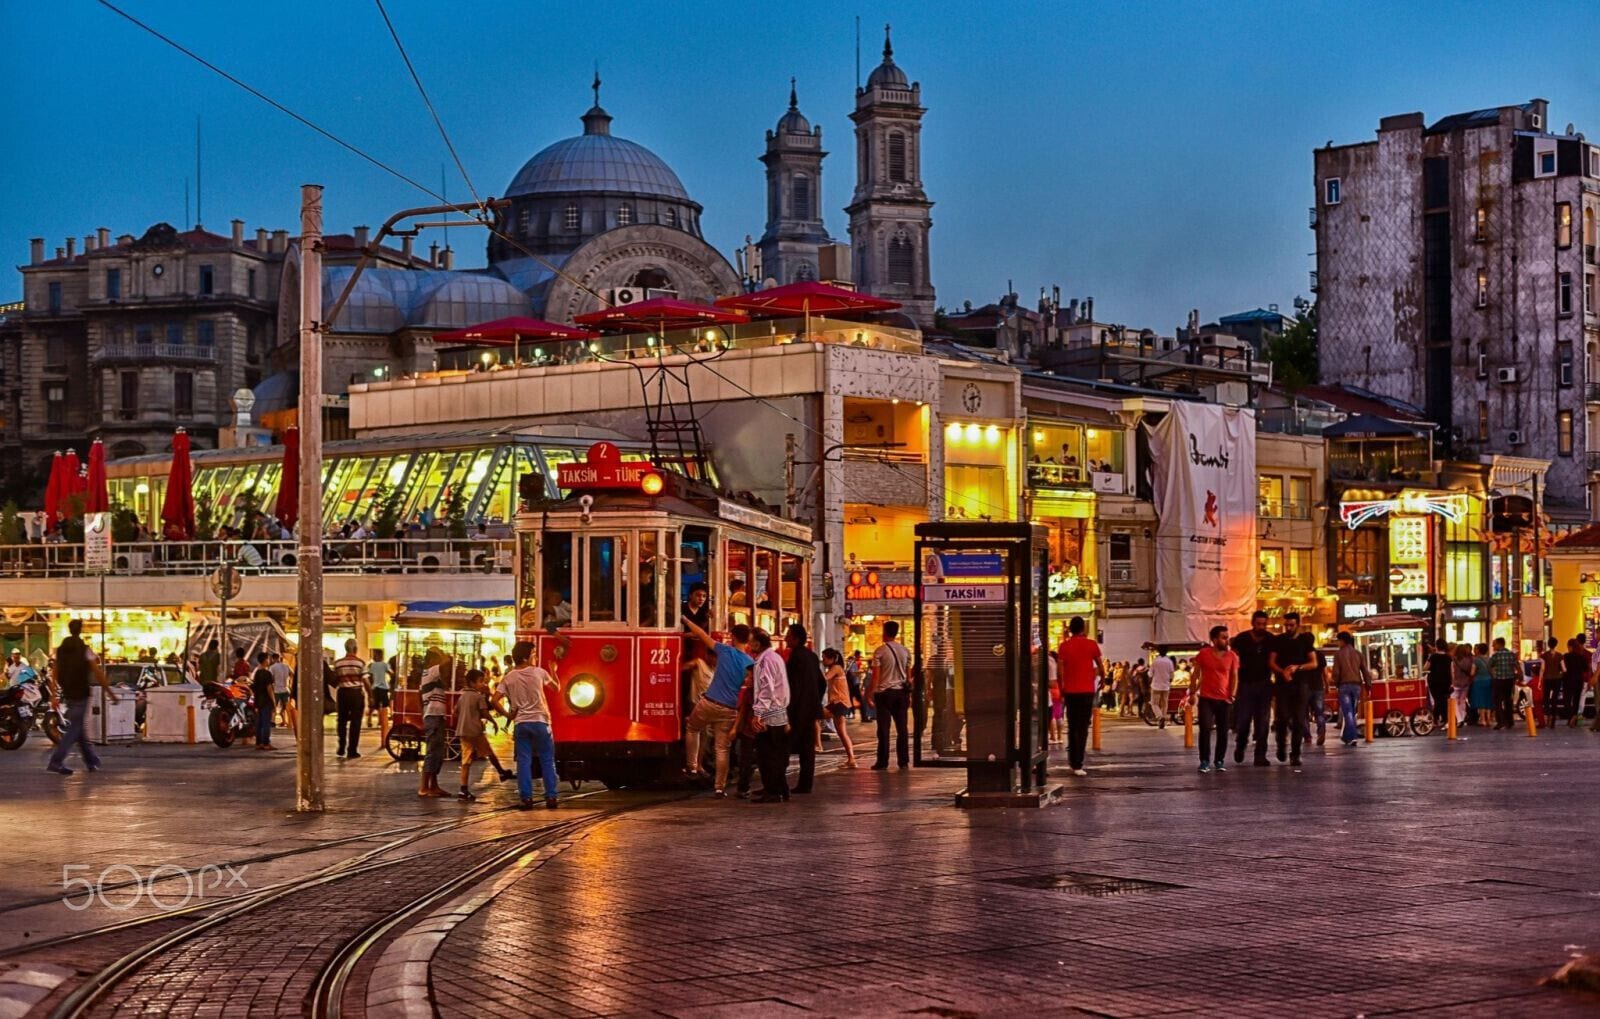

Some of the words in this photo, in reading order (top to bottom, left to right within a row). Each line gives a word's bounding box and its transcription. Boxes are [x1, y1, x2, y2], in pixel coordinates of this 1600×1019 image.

[600, 443, 607, 458] 2
[562, 467, 597, 483] TAKSİM
[615, 467, 645, 482] TÜNE
[944, 587, 986, 599] TAKSİM
[650, 649, 671, 665] 223
